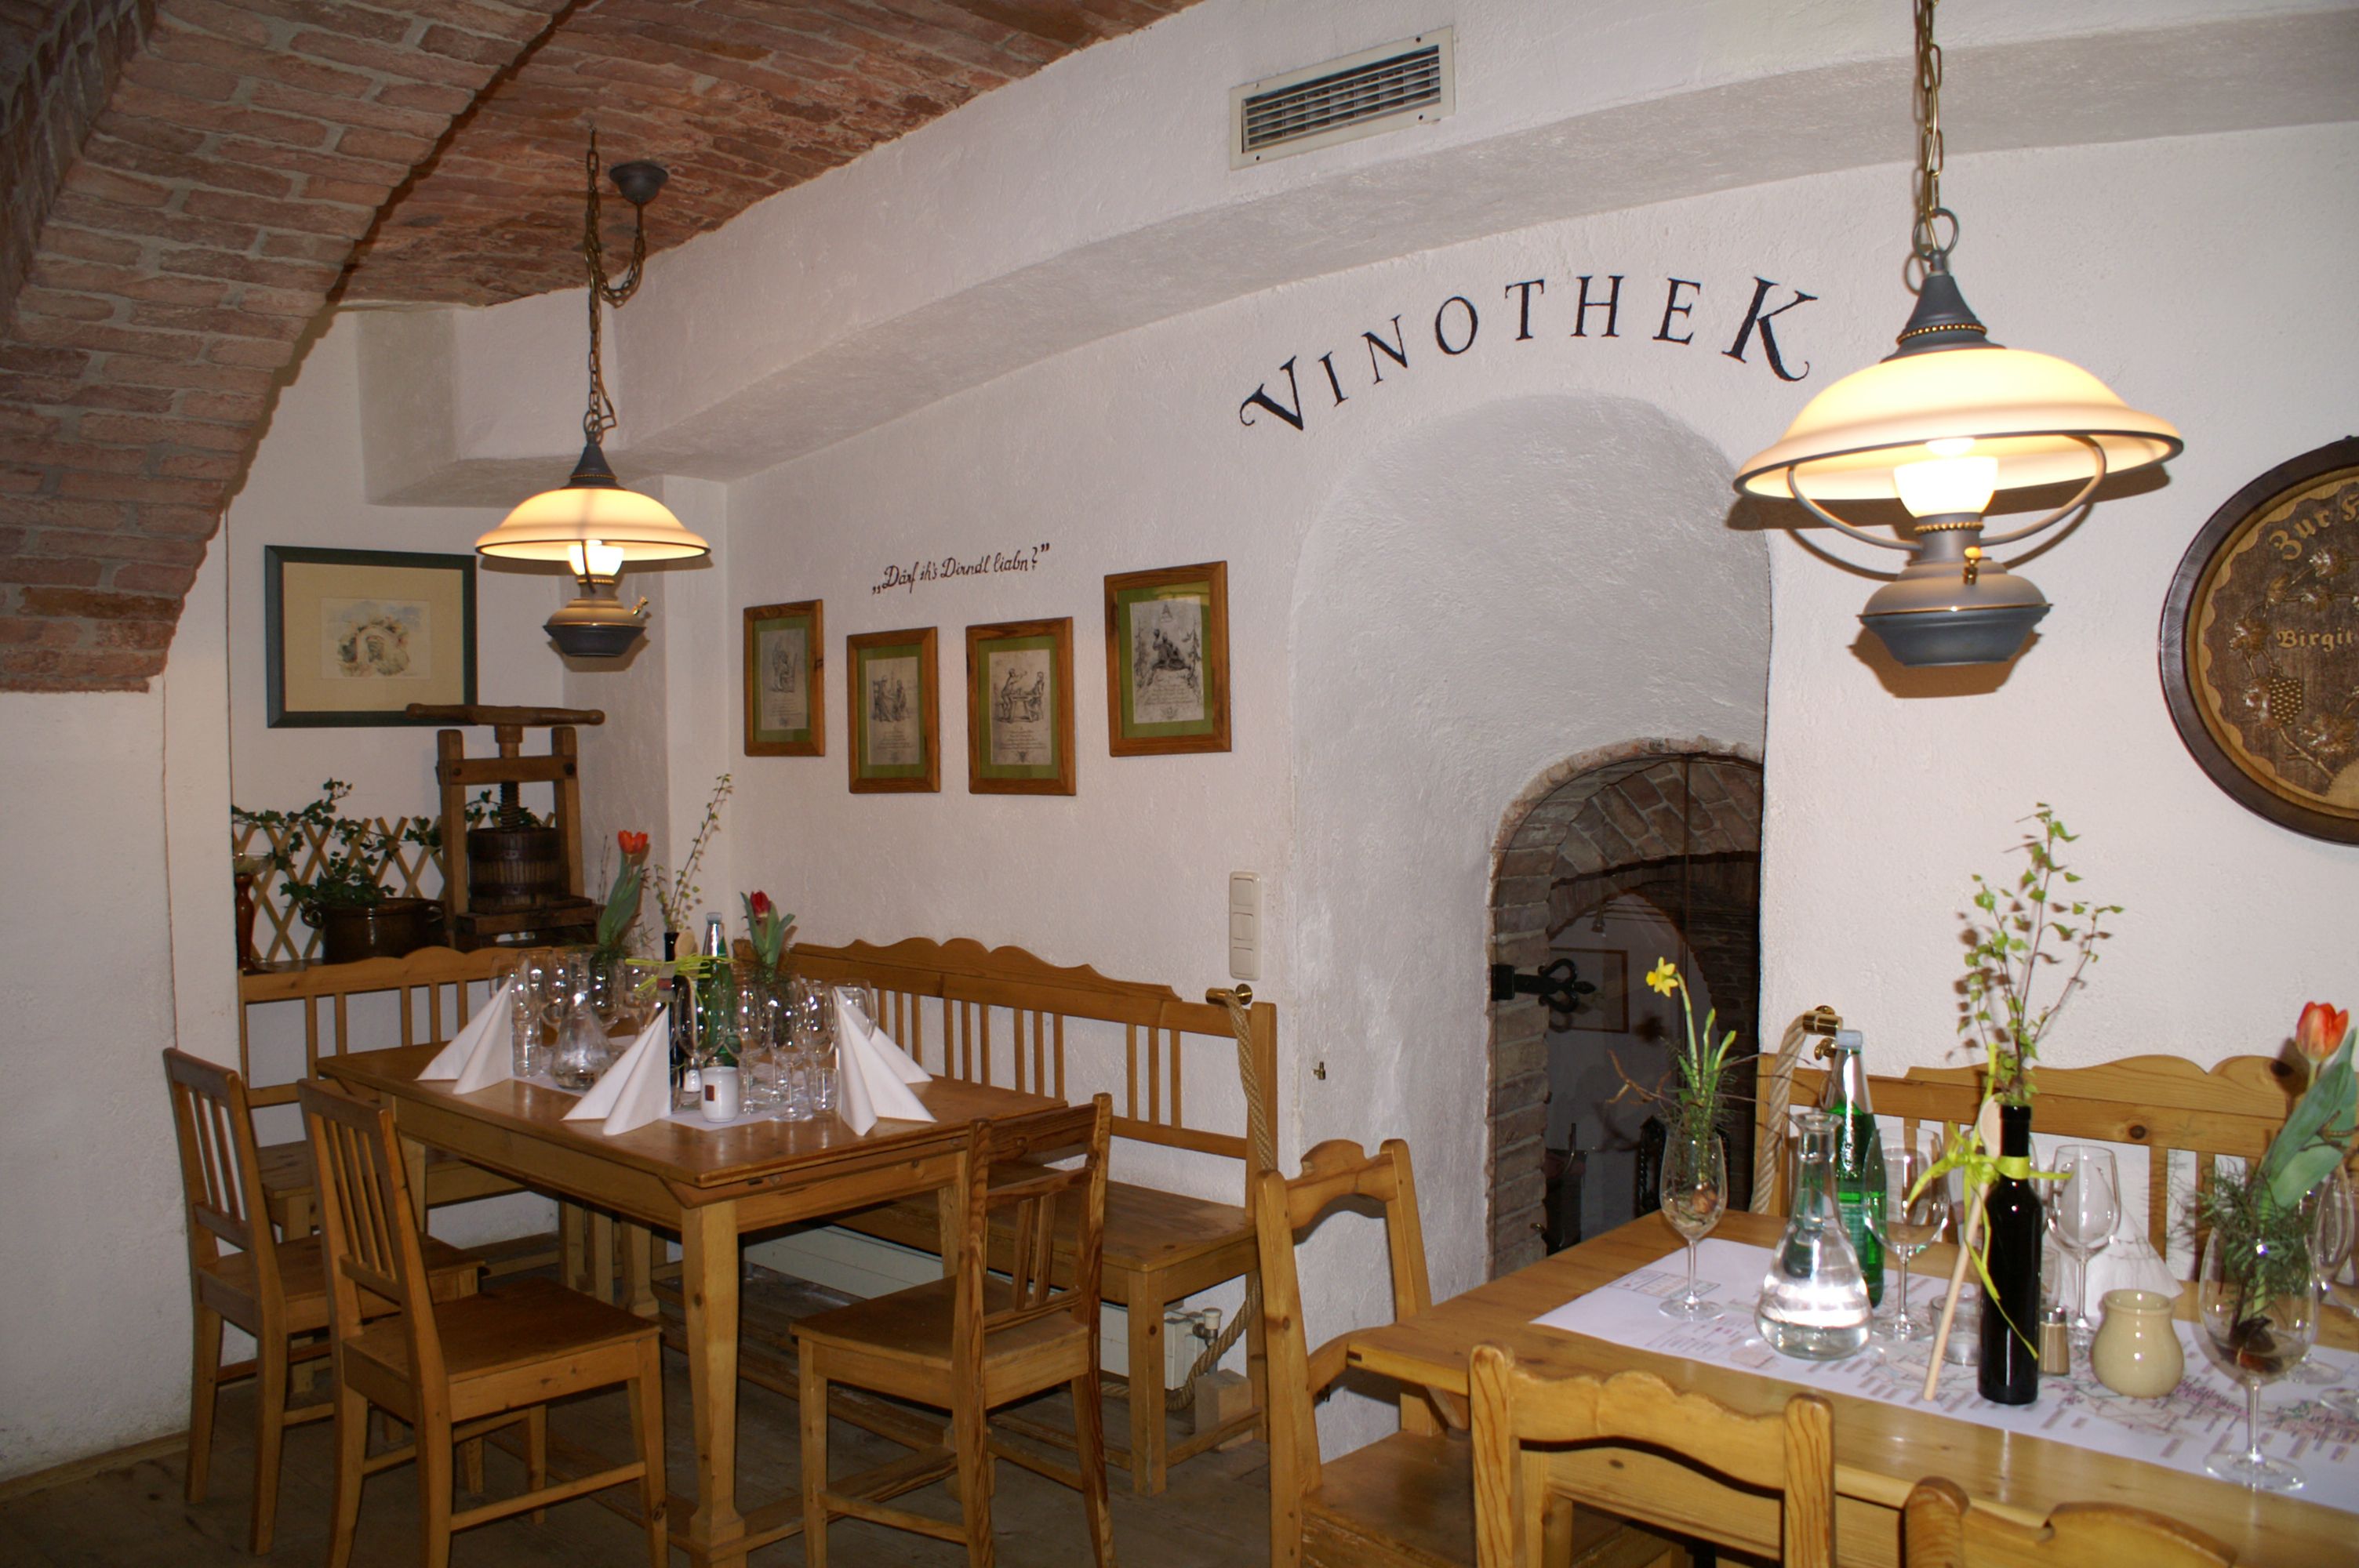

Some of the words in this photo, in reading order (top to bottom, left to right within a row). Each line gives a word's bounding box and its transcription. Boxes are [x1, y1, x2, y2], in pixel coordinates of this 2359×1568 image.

[1239, 275, 1819, 431] VINOTHEK
[2268, 509, 2330, 561] Zur
[2276, 626, 2354, 652] Birgit
